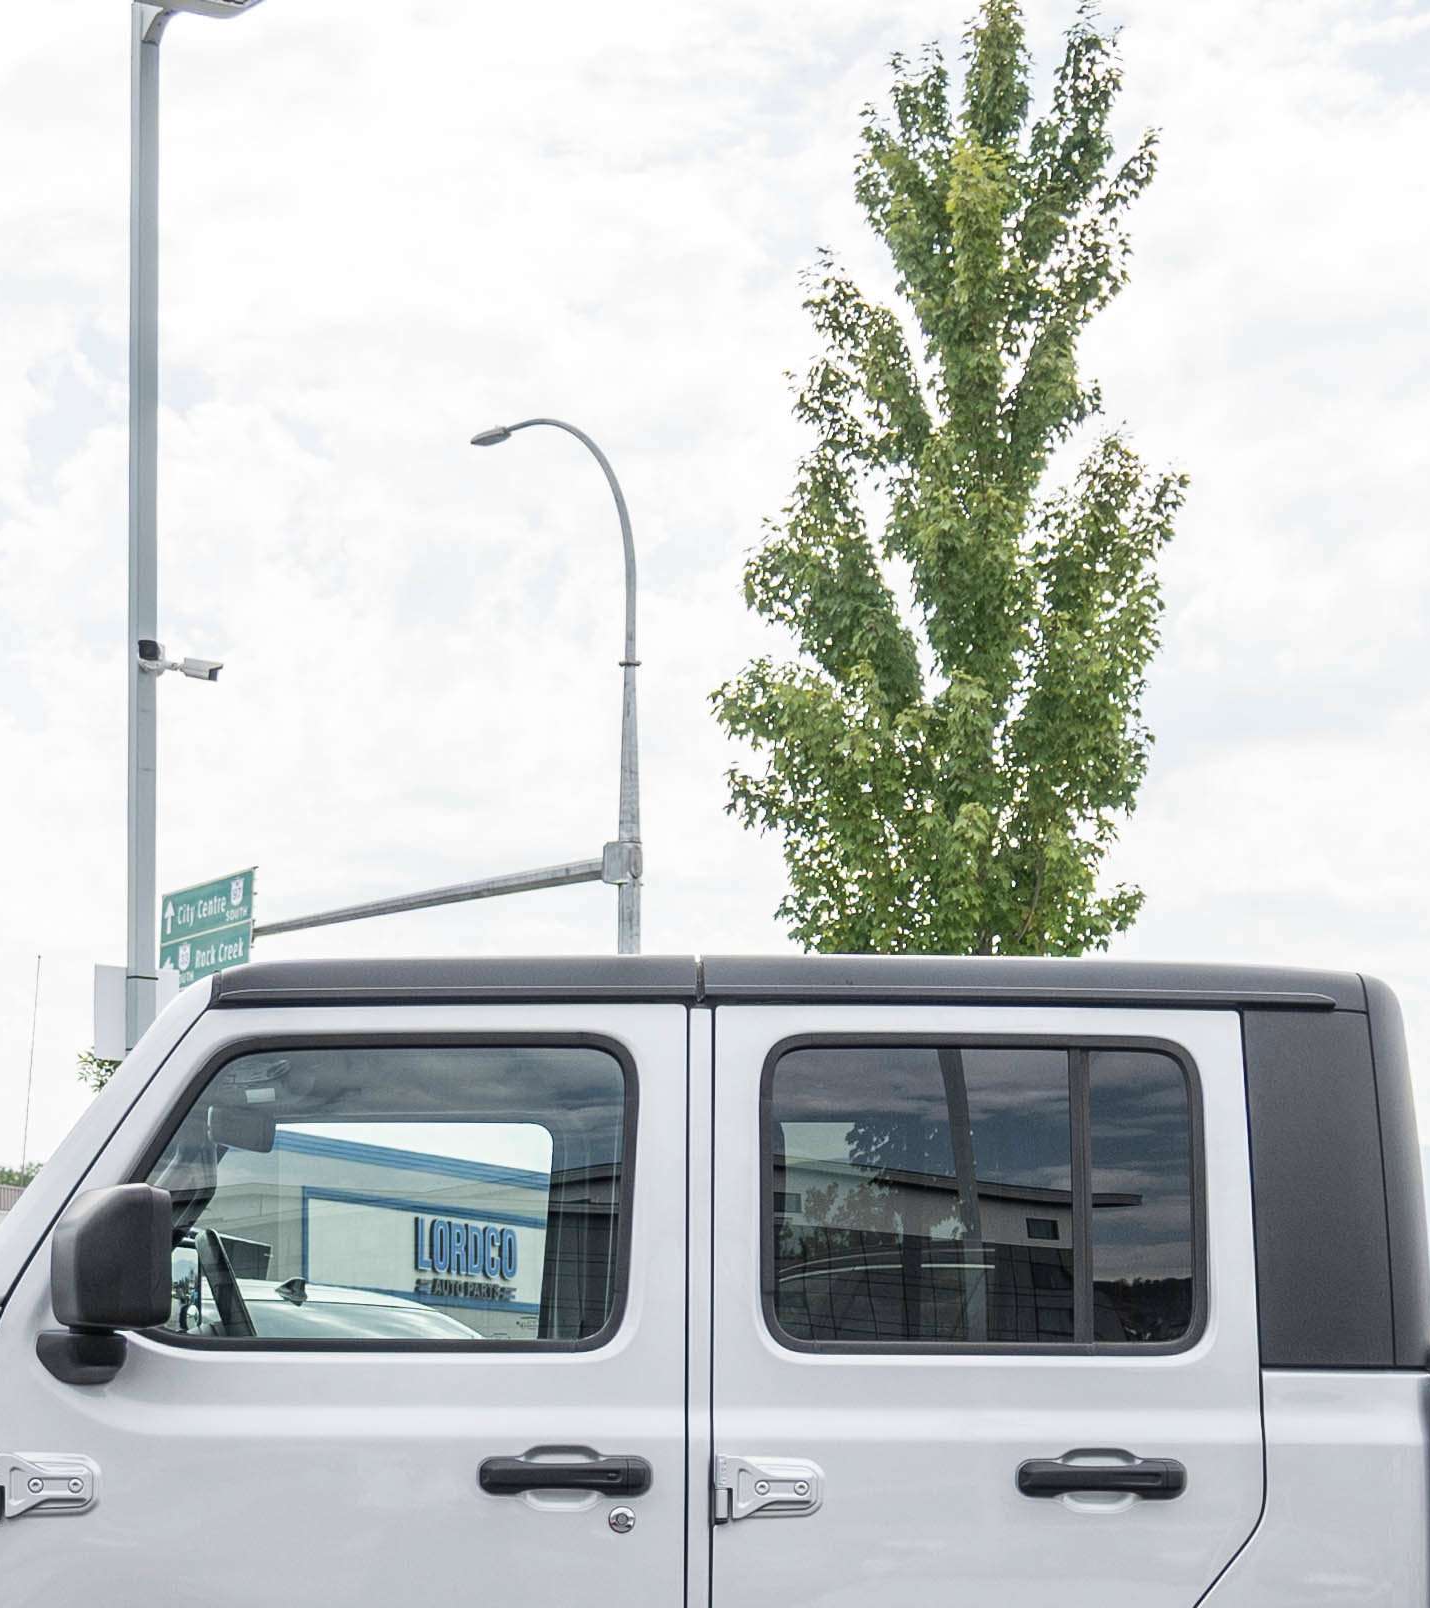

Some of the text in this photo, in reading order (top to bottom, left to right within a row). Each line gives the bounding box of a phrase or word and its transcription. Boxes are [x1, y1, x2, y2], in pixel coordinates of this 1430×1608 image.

[177, 895, 227, 927] City Centre
[225, 906, 249, 921] SOUTH
[195, 937, 244, 968] Rock Creek
[415, 1217, 517, 1281] LORDCO
[433, 1279, 501, 1301] AUTO PARTS
